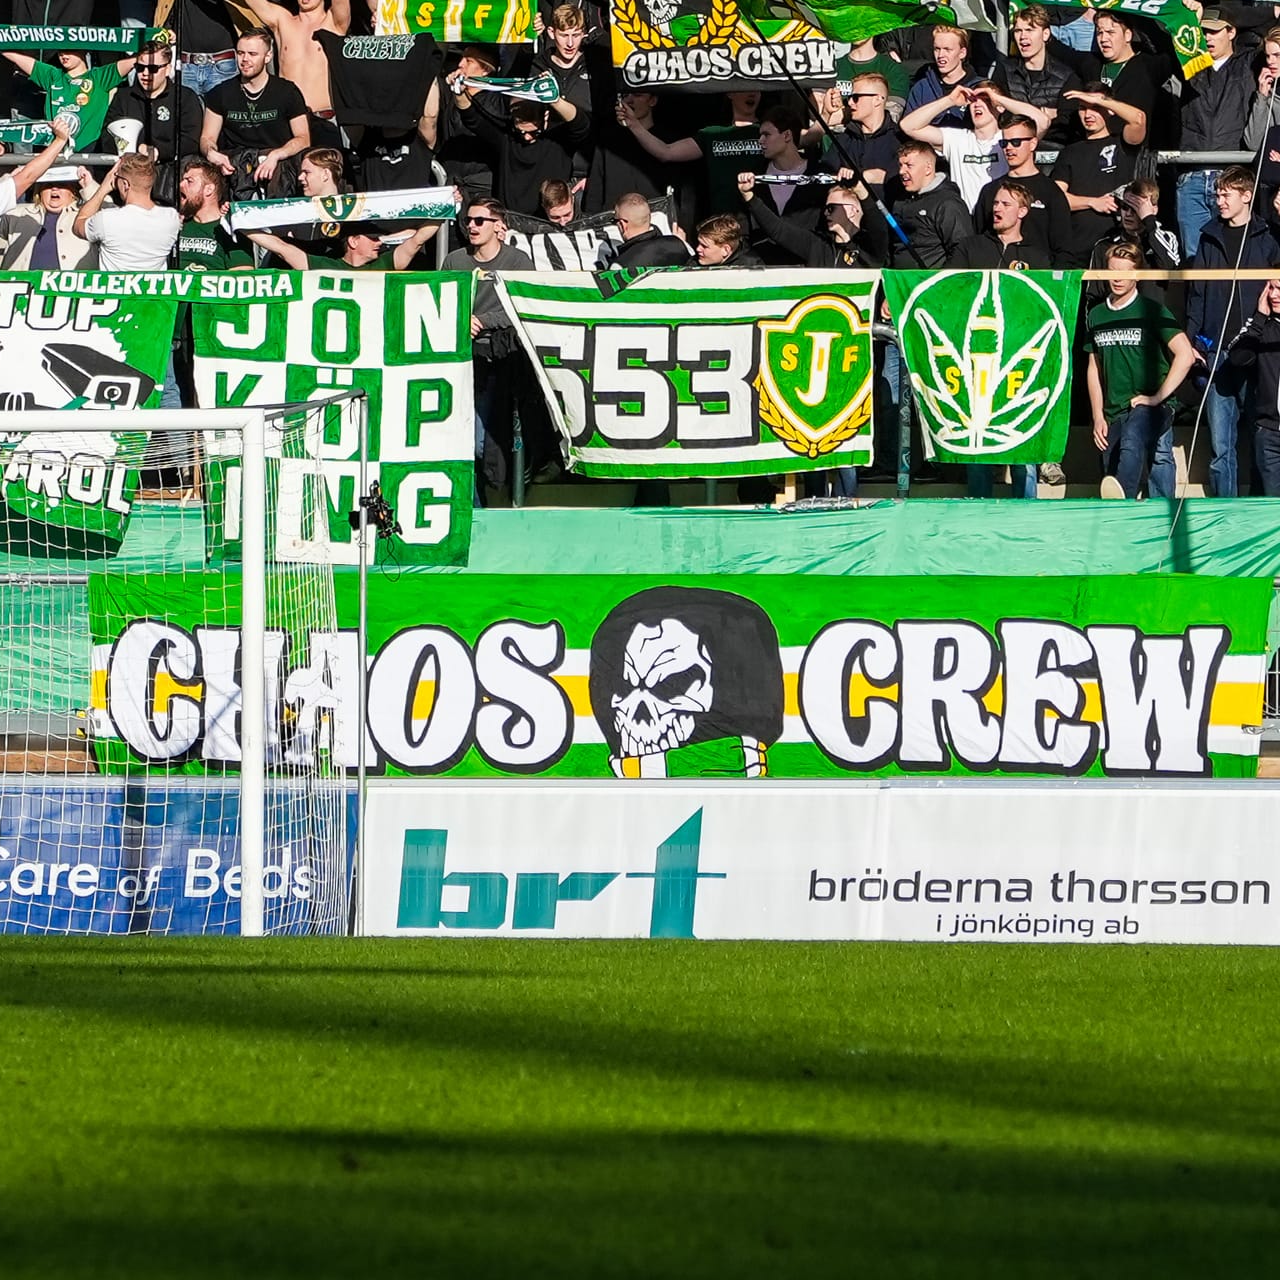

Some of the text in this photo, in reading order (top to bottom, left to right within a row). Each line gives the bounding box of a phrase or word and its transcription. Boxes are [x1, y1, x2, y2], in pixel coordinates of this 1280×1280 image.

[67, 26, 118, 45] SÖDRA
[120, 27, 135, 43] IF
[341, 38, 415, 61] CREW
[624, 39, 837, 85] CHAOS CREW
[40, 271, 193, 298] KOLLEKTIV
[798, 616, 1231, 777] CREW
[119, 865, 162, 906] of
[397, 805, 728, 939] brt
[809, 868, 1271, 906] bröderna thorsson
[950, 913, 1095, 938] jönköping
[1104, 914, 1139, 935] ab
